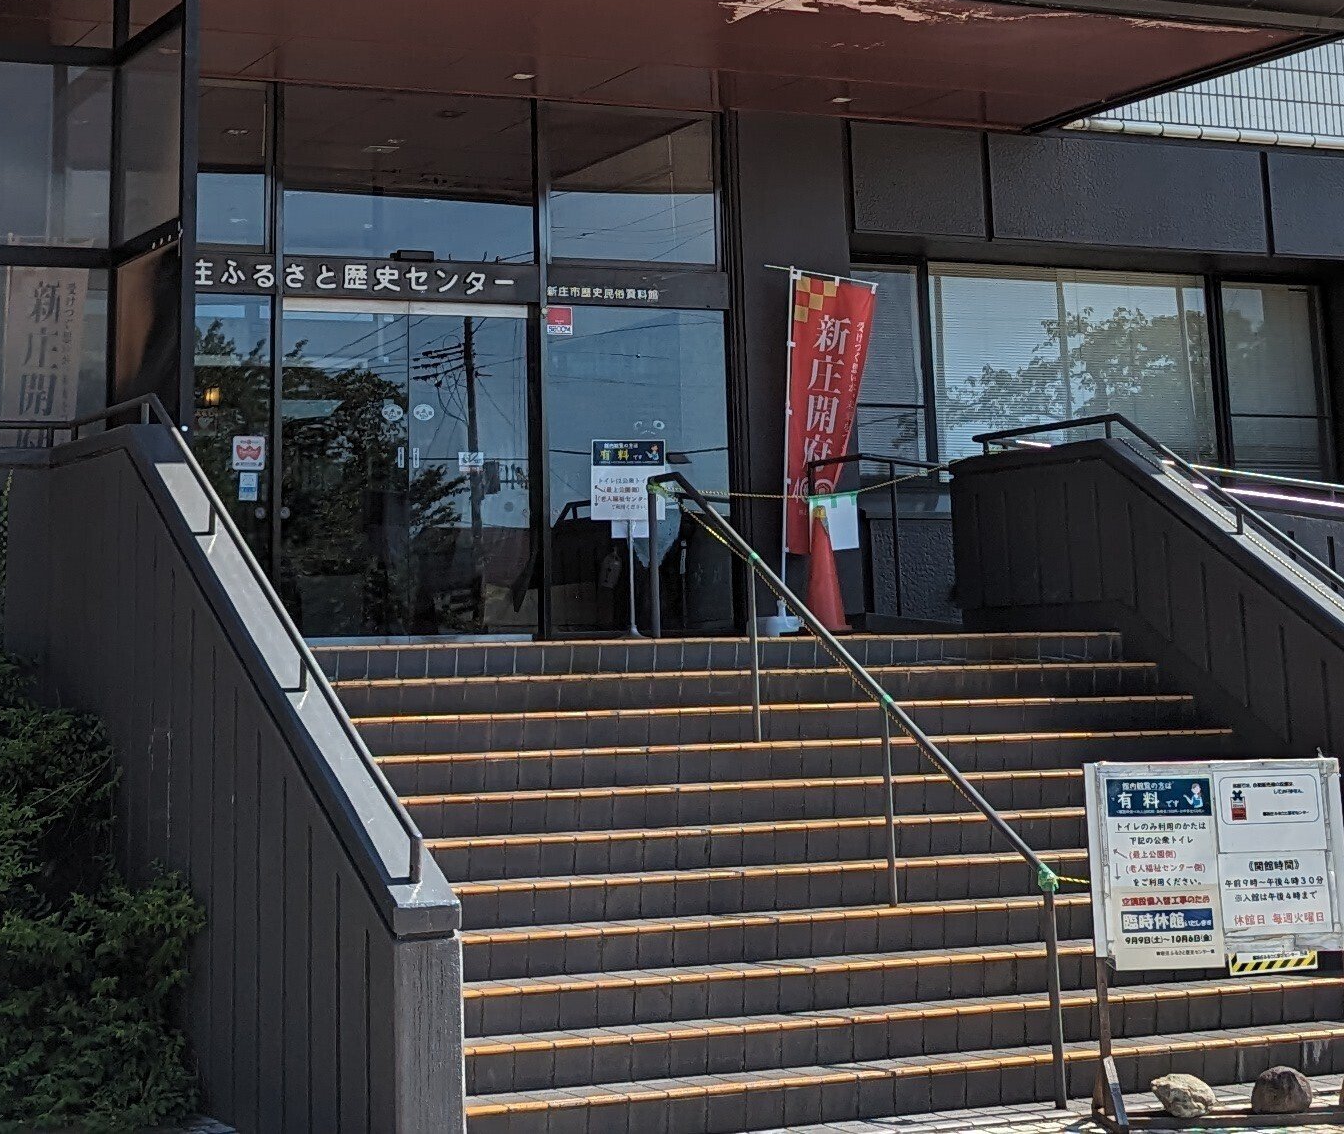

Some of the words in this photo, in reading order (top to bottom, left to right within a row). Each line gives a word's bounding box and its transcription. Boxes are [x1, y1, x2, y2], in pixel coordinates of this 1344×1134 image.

[802, 314, 853, 472] 新庄開府
[1117, 822, 1207, 832] トイレのみ利用のかたは
[1129, 836, 1194, 845] 下記の公衆トイレ
